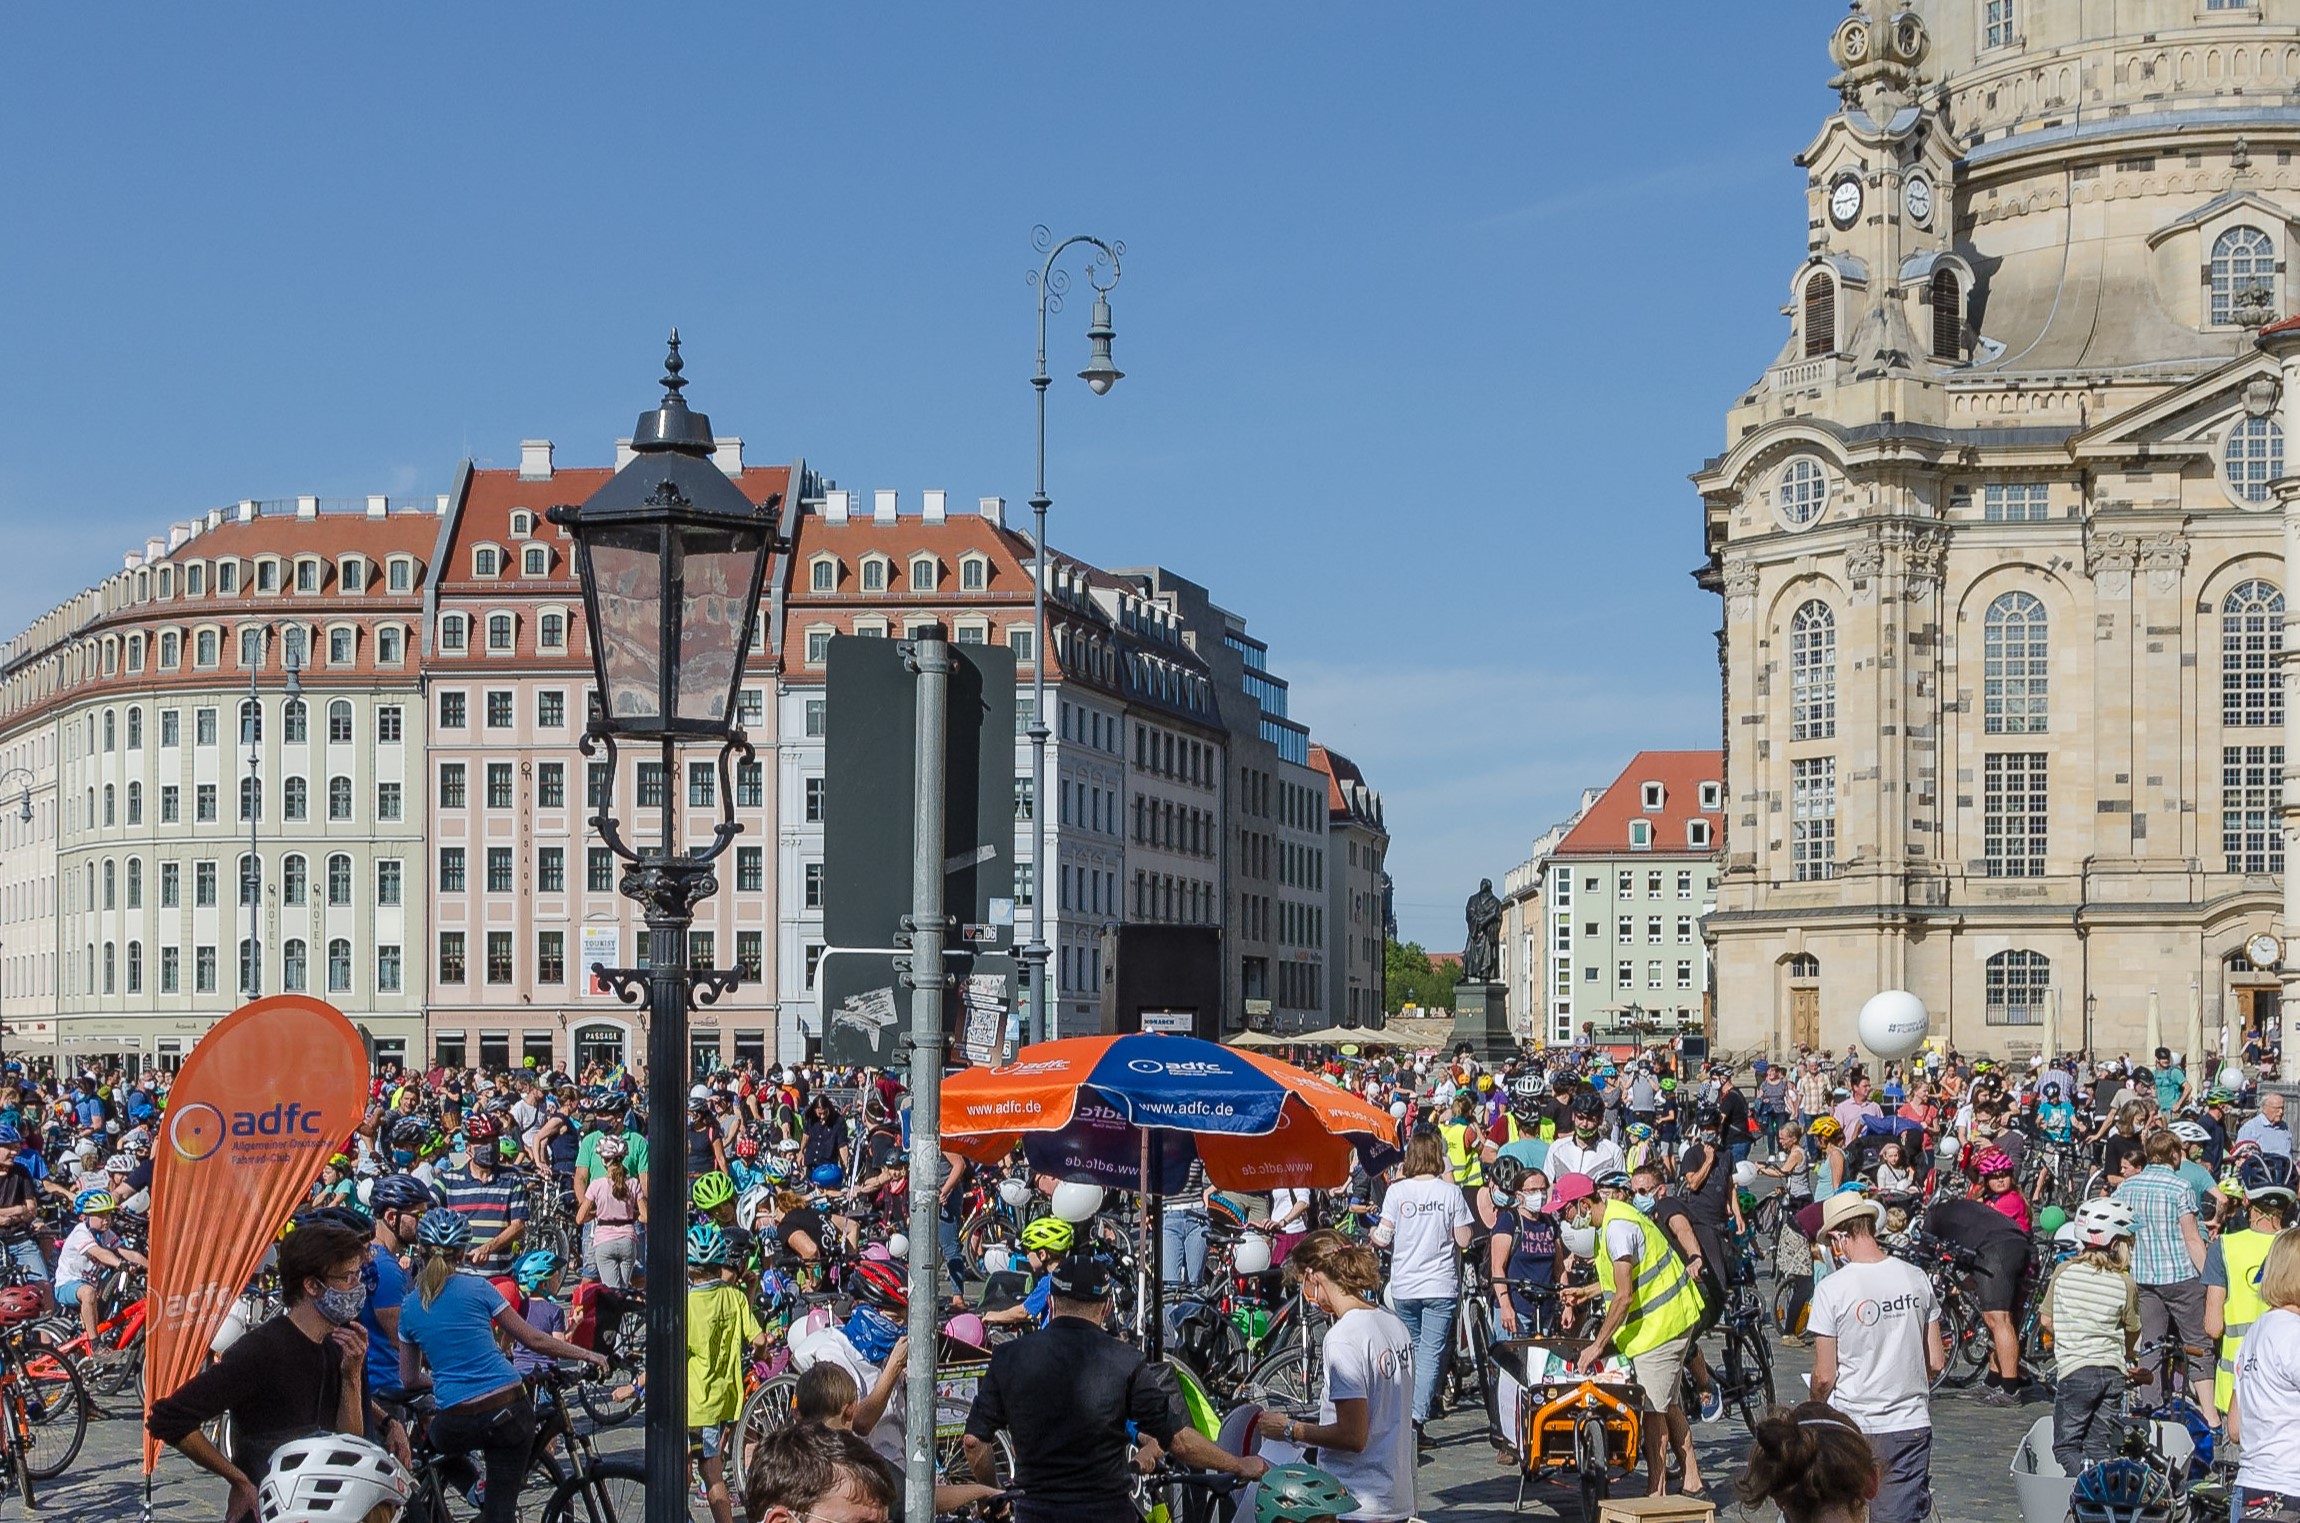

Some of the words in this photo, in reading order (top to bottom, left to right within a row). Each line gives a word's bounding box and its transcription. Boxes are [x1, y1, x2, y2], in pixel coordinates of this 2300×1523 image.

[985, 926, 996, 939] 06
[585, 1032, 618, 1041] PASSAGE
[1165, 1061, 1221, 1071] adfc
[966, 1099, 1042, 1116] www.adfc.de
[1138, 1101, 1234, 1117] www.adfc.de
[232, 1103, 322, 1136] adfc
[1418, 1200, 1444, 1212] adfc
[166, 1281, 230, 1318] adfc
[1882, 1293, 1919, 1312] adfc
